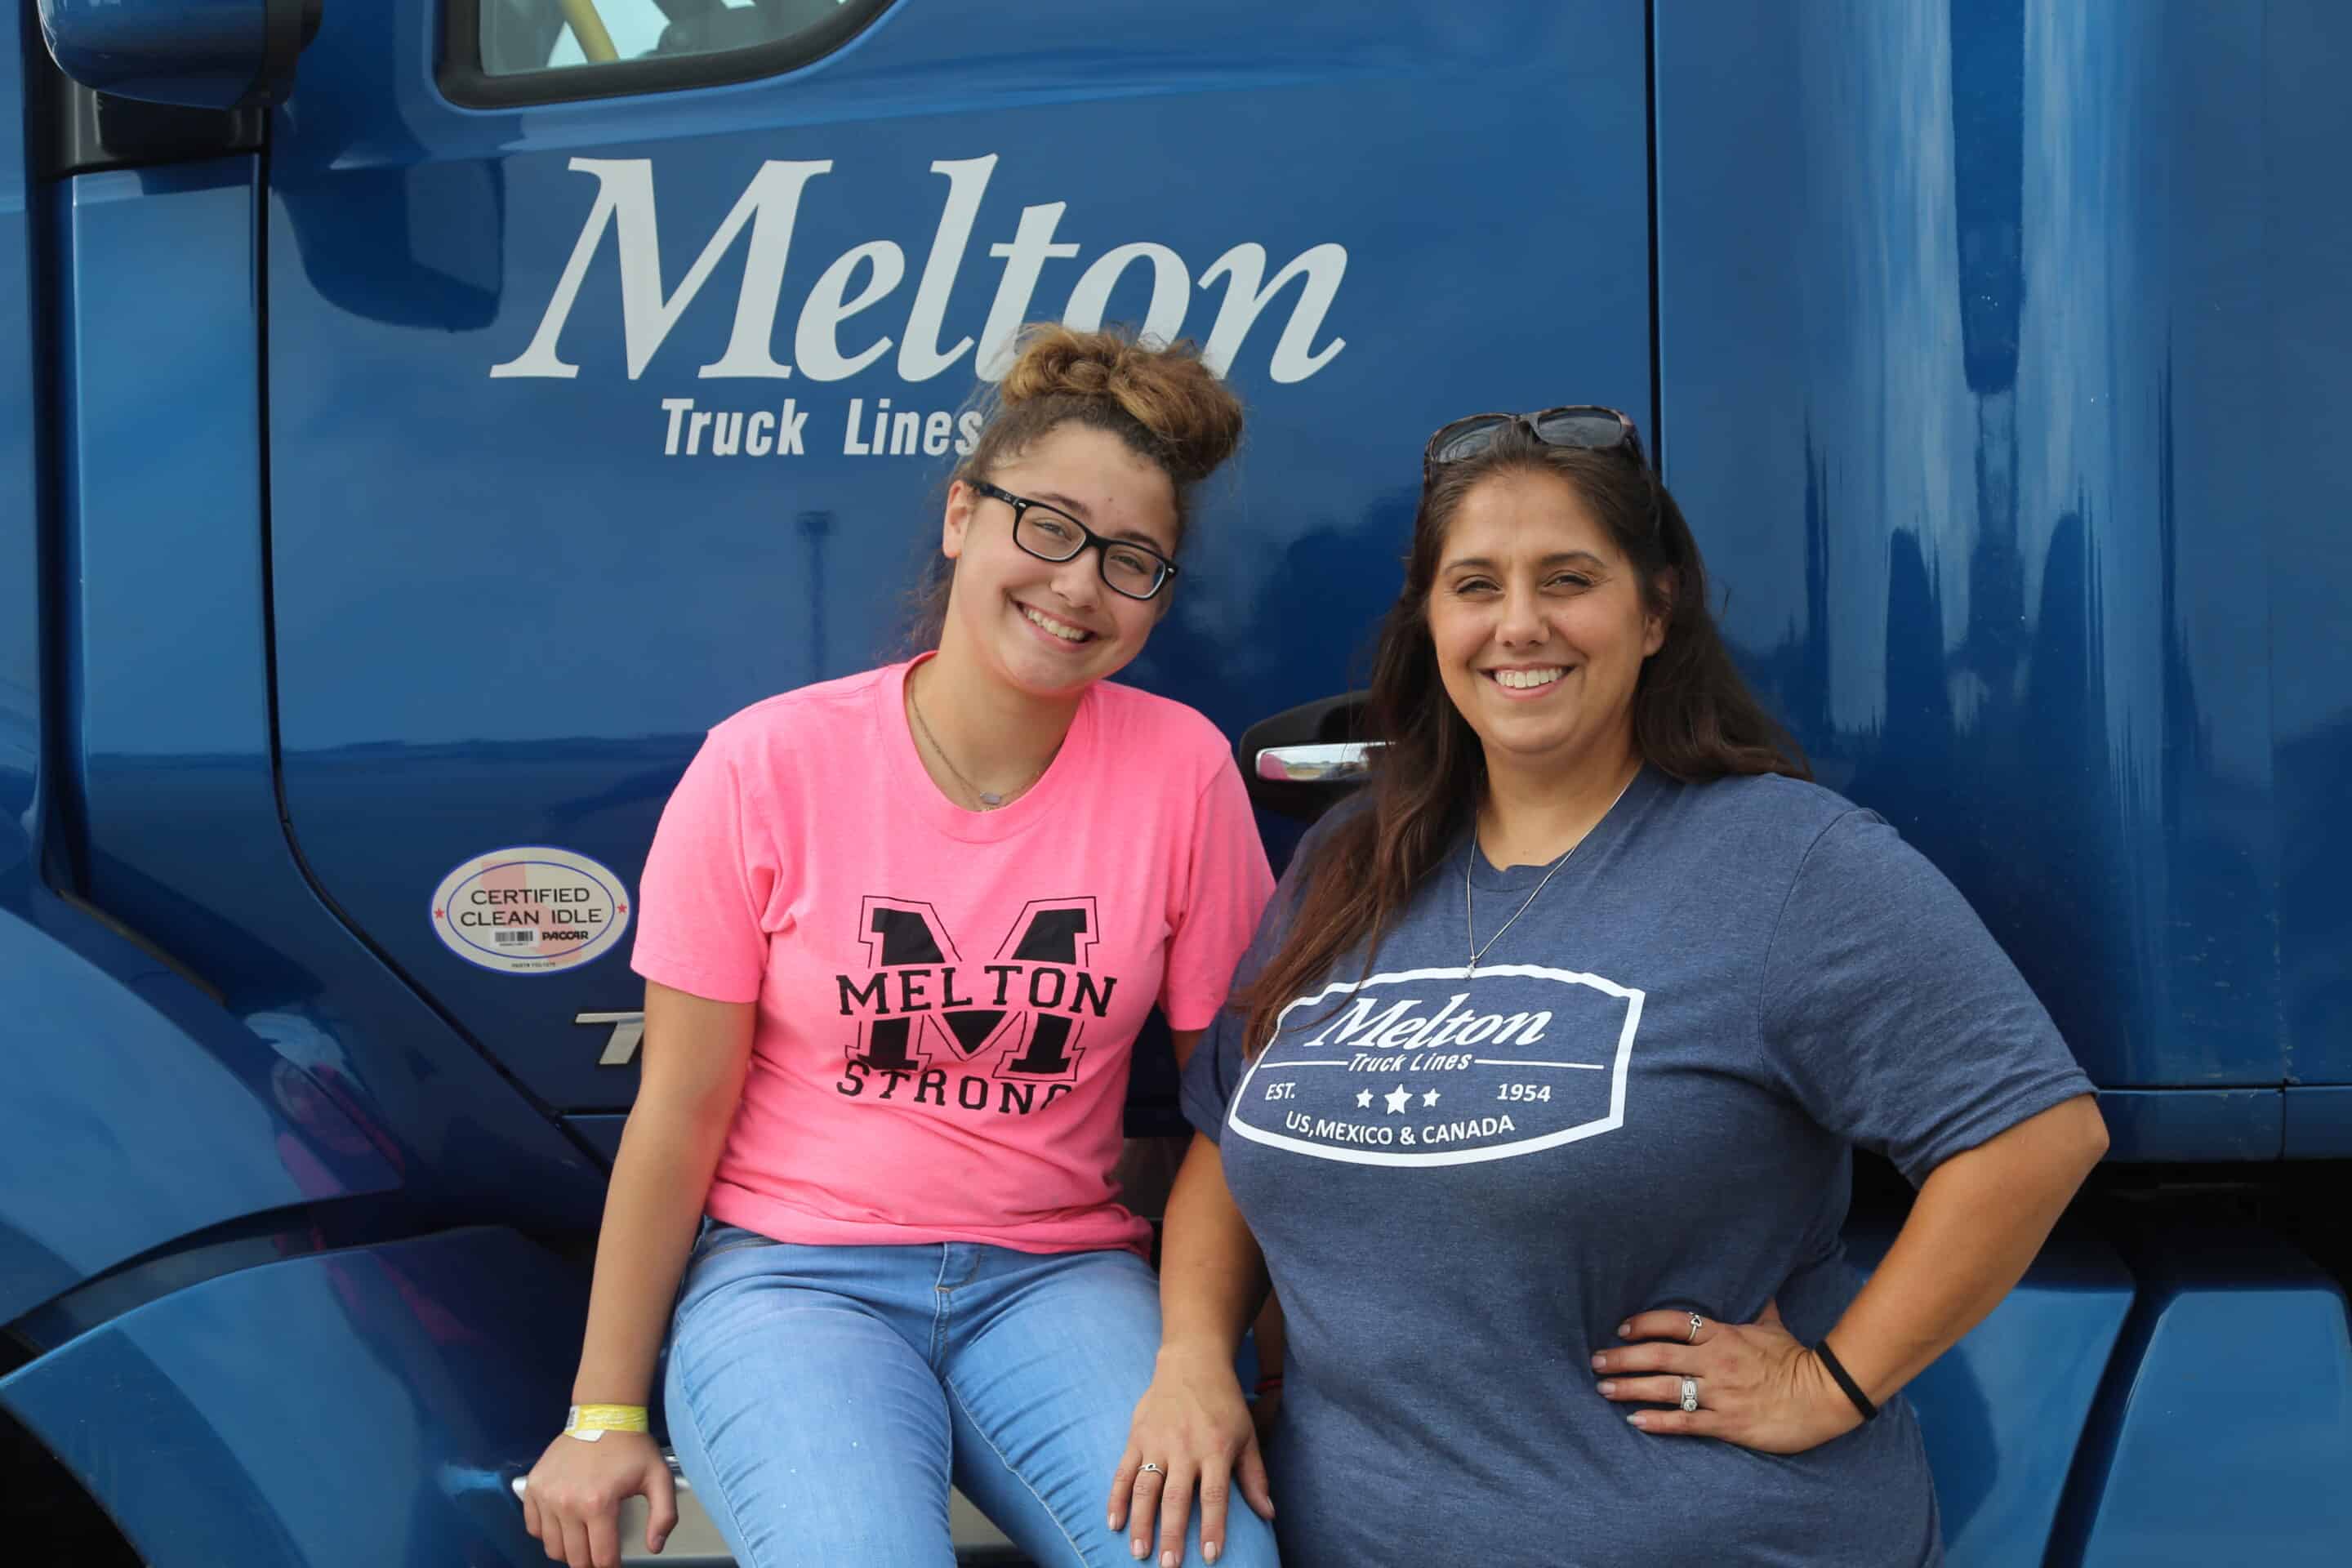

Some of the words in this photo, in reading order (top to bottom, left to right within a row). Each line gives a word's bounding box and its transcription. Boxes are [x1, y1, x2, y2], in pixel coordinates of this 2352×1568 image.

[490, 154, 1348, 384] Melton
[661, 399, 808, 457] Truck
[843, 399, 983, 457] Lines
[470, 887, 590, 906] CERTIFIED
[460, 909, 540, 927] CLEAN
[551, 908, 603, 924] IDLE
[541, 929, 589, 942] PACCAR
[835, 965, 1118, 1018] MELTON
[1303, 991, 1553, 1050] Melton
[1348, 1052, 1408, 1072] Truck
[1410, 1052, 1473, 1072] Lines
[1264, 1081, 1296, 1101] EST.
[1496, 1083, 1552, 1102] 1954
[1400, 1125, 1417, 1145] &
[1421, 1115, 1517, 1145] CANADA
